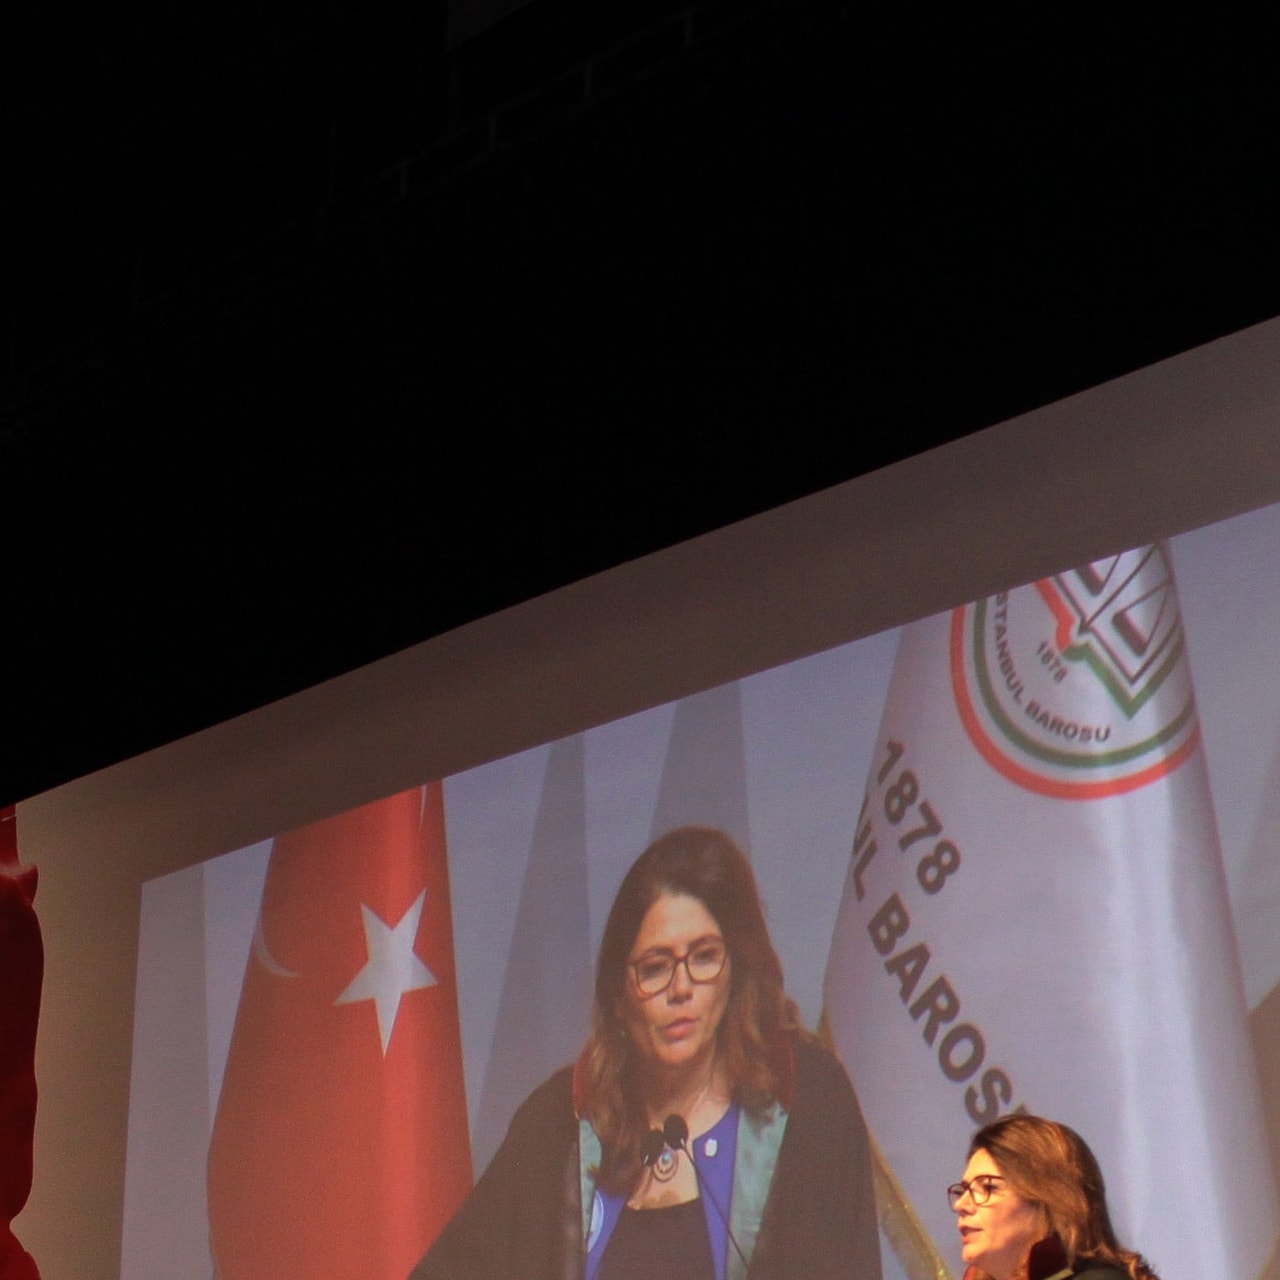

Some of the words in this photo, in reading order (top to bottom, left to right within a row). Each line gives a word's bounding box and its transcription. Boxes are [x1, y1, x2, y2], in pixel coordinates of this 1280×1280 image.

[1036, 640, 1068, 684] 1878
[1025, 700, 1111, 743] BAROSU
[878, 739, 962, 895] 1878
[867, 890, 1030, 1127] BAROS
